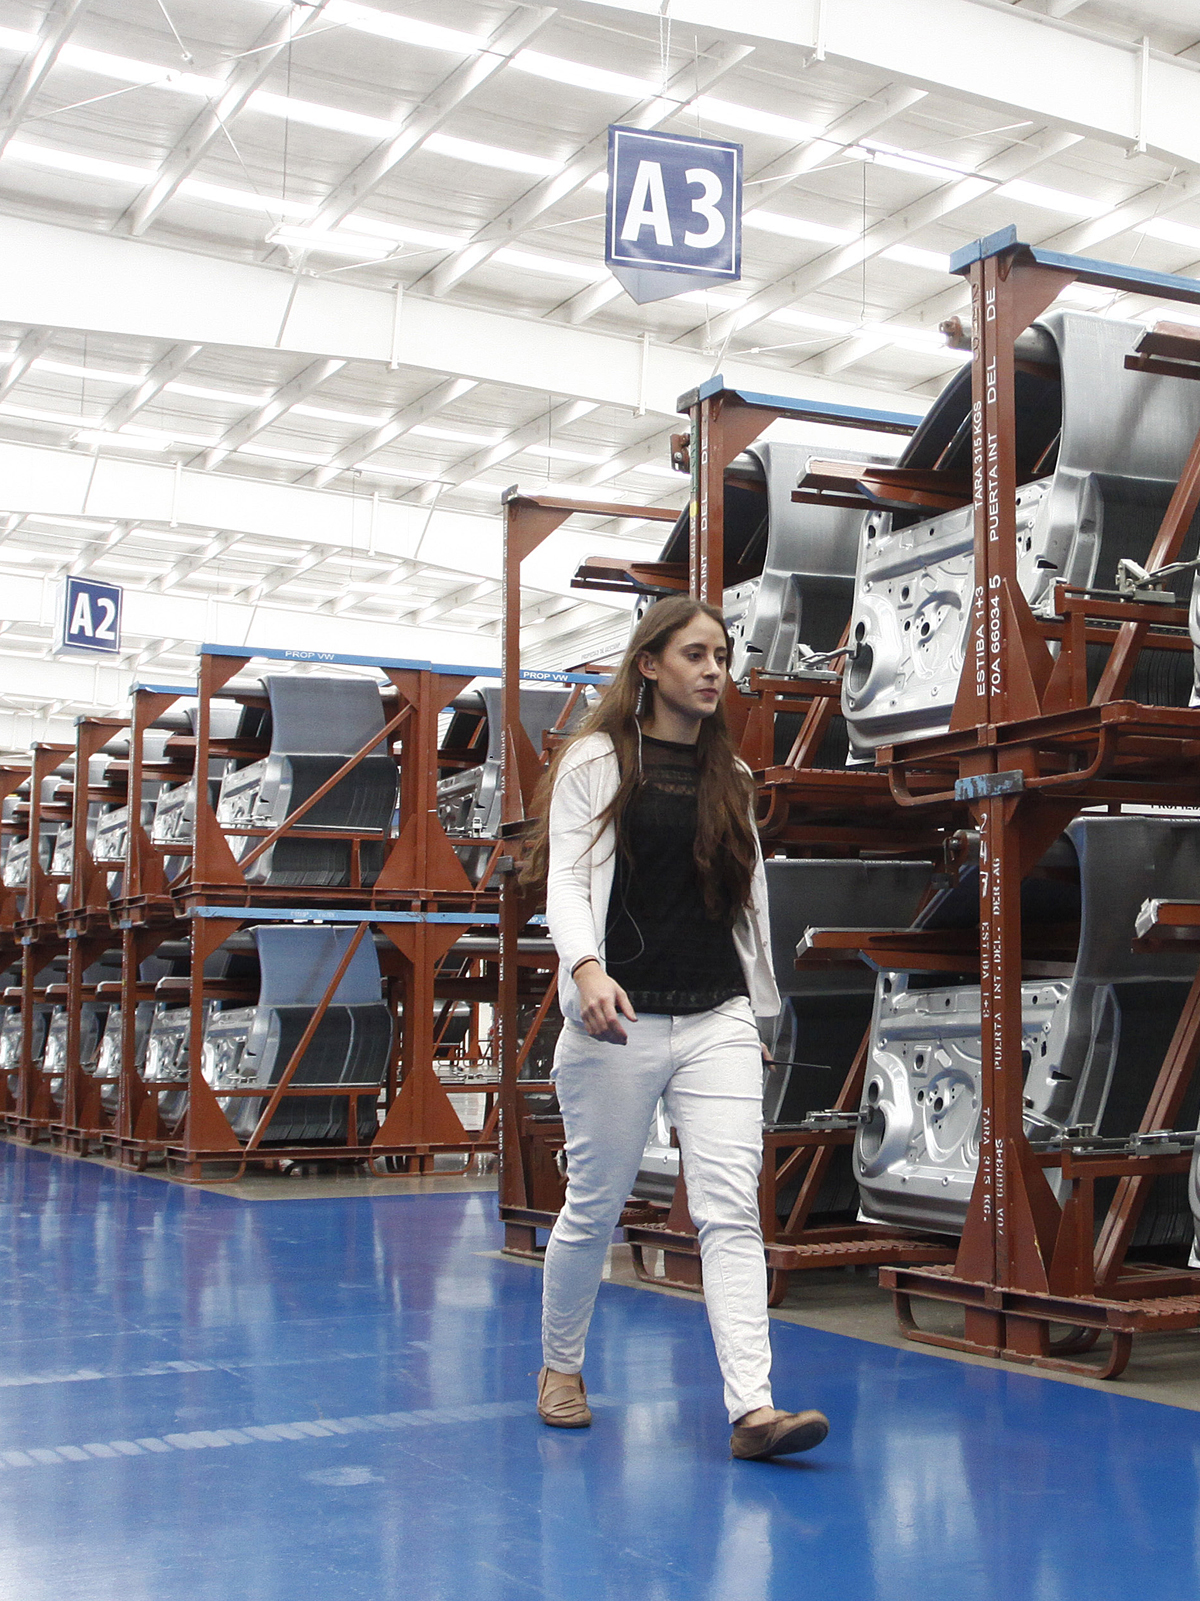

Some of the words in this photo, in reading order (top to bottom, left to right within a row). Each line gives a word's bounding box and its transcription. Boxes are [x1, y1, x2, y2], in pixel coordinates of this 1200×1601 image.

[620, 160, 726, 249] A3
[986, 286, 996, 322] DE
[987, 355, 997, 404] DEL
[973, 400, 982, 435] KGS
[702, 436, 708, 465] DE
[974, 437, 983, 464] 315
[987, 432, 997, 462] INT
[974, 466, 983, 511] TARA
[989, 464, 999, 542] PUERTA
[700, 554, 708, 582] INT
[70, 592, 115, 640] A2
[975, 585, 984, 619] 1+3
[285, 651, 315, 659] PROP
[975, 624, 986, 696] ESTIBA
[523, 671, 550, 679] PROP
[991, 658, 1001, 697] 70A
[979, 813, 989, 898] 247
[994, 1012, 1002, 1070] PUERTA
